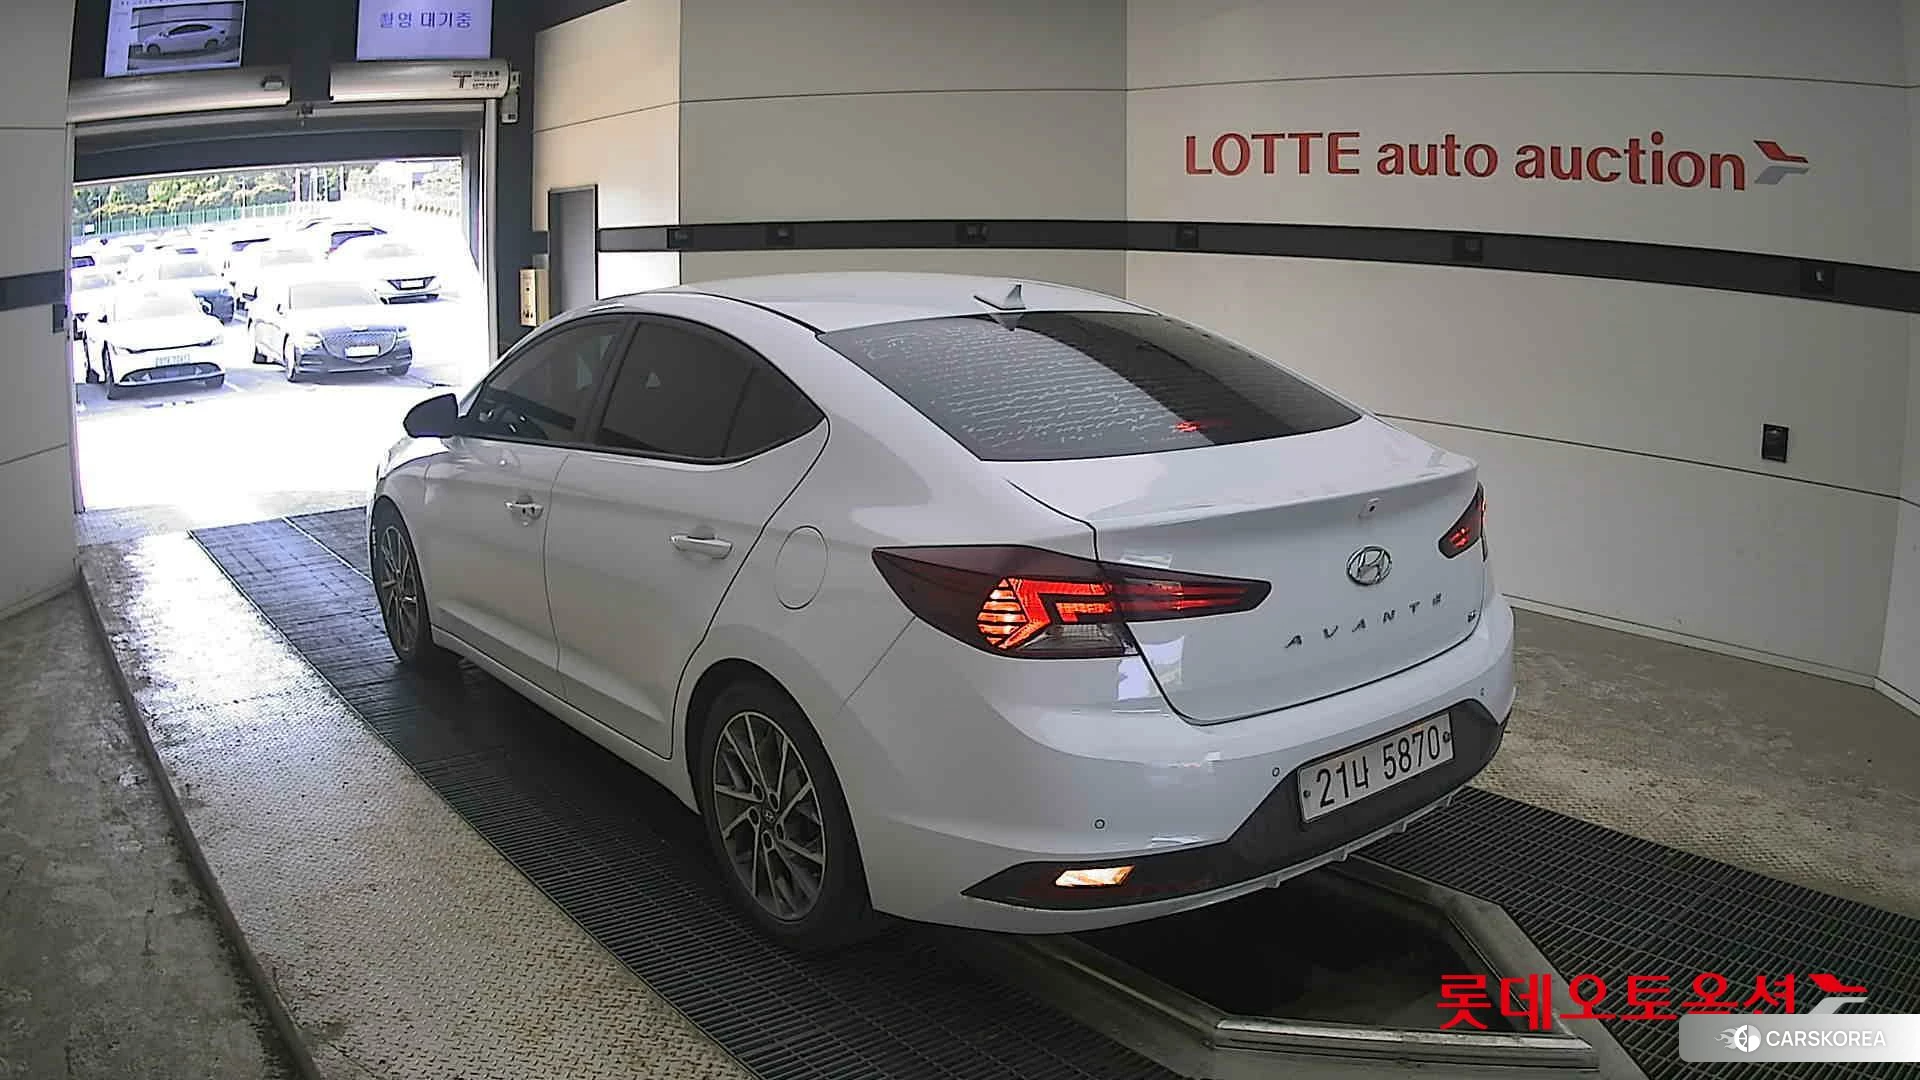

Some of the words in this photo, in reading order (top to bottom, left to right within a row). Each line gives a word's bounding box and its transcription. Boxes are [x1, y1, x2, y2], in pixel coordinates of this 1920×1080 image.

[420, 11, 472, 28] 대기중
[1185, 132, 1360, 176] LOTTE
[1376, 133, 1499, 177] auto
[1514, 131, 1745, 191] auction
[1382, 725, 1441, 780] 5870
